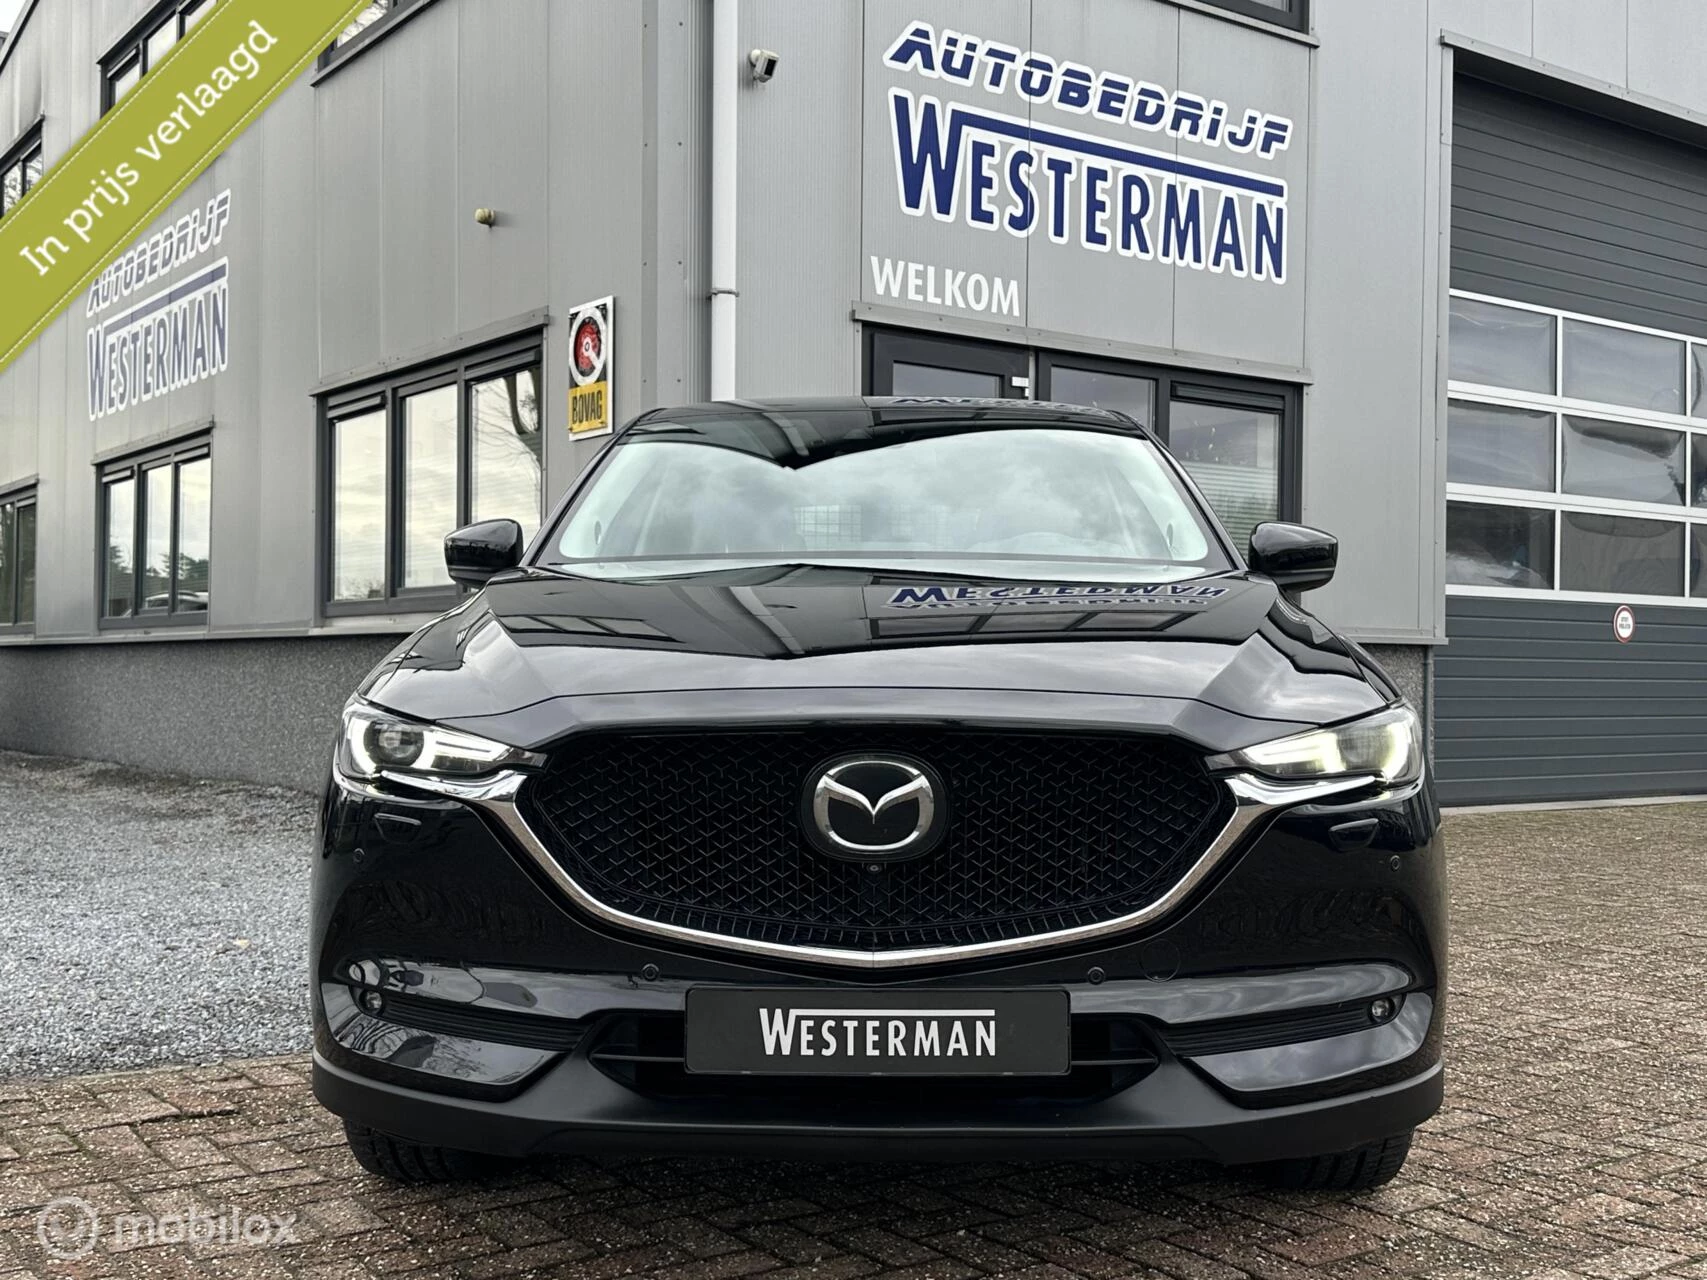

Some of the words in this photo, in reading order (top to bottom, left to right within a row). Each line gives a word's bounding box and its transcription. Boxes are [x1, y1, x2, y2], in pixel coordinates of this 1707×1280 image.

[884, 22, 1291, 158] AUTOBEDRIJF
[889, 88, 1288, 283] WESTERMAN
[870, 256, 1020, 317] WELKOM
[87, 257, 229, 420] WESTERMAN
[572, 390, 603, 424] BOVAG
[759, 1008, 996, 1056] WESTERMAN
